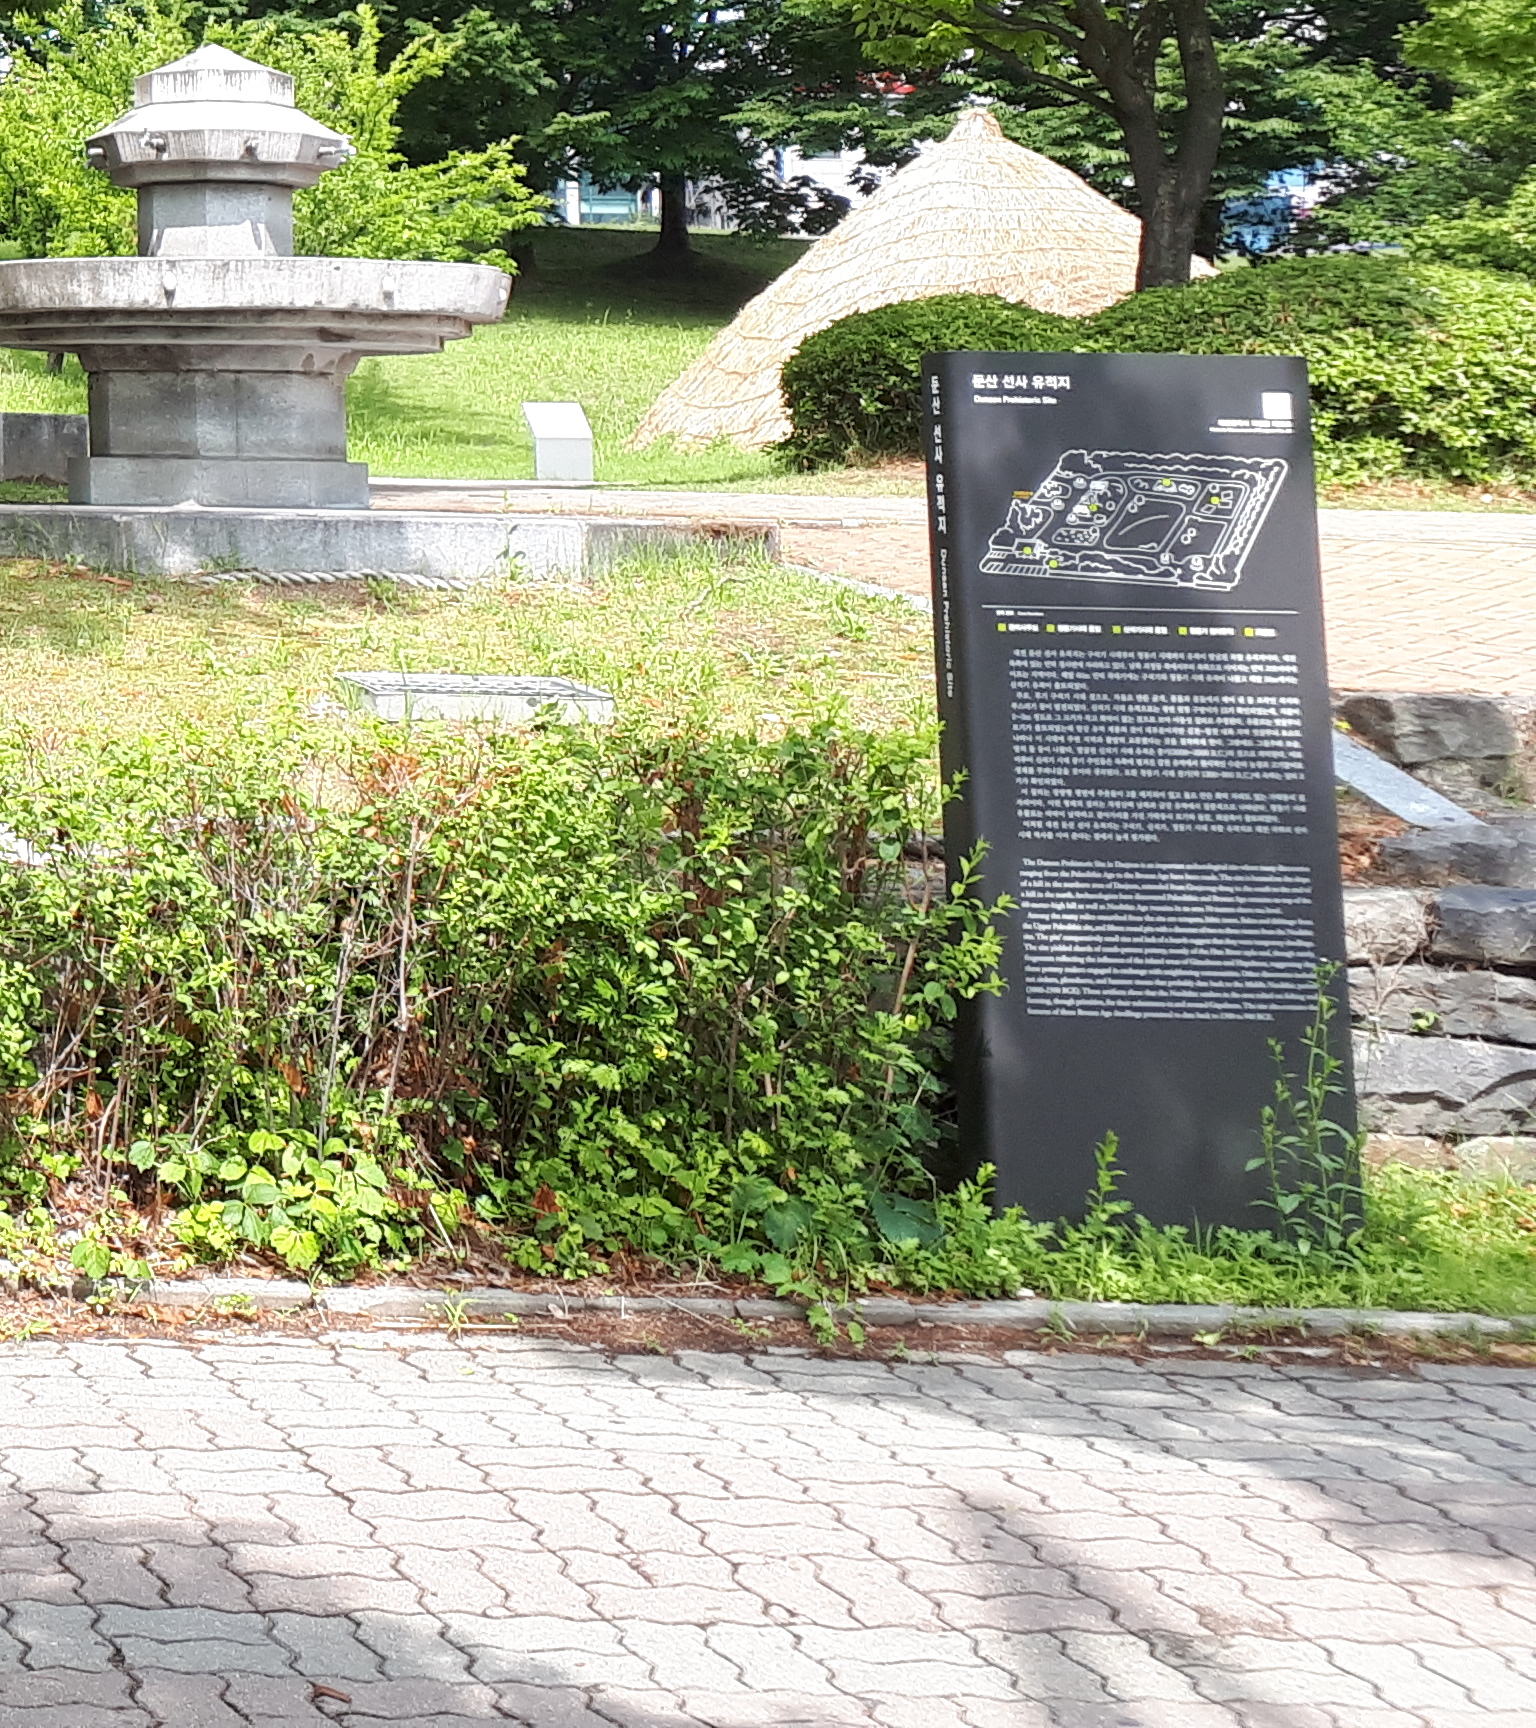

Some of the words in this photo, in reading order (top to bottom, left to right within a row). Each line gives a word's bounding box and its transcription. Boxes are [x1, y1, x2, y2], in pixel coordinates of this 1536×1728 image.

[1002, 374, 1028, 390] 선사
[1031, 375, 1071, 390] 유적지
[936, 474, 947, 534] 유적지
